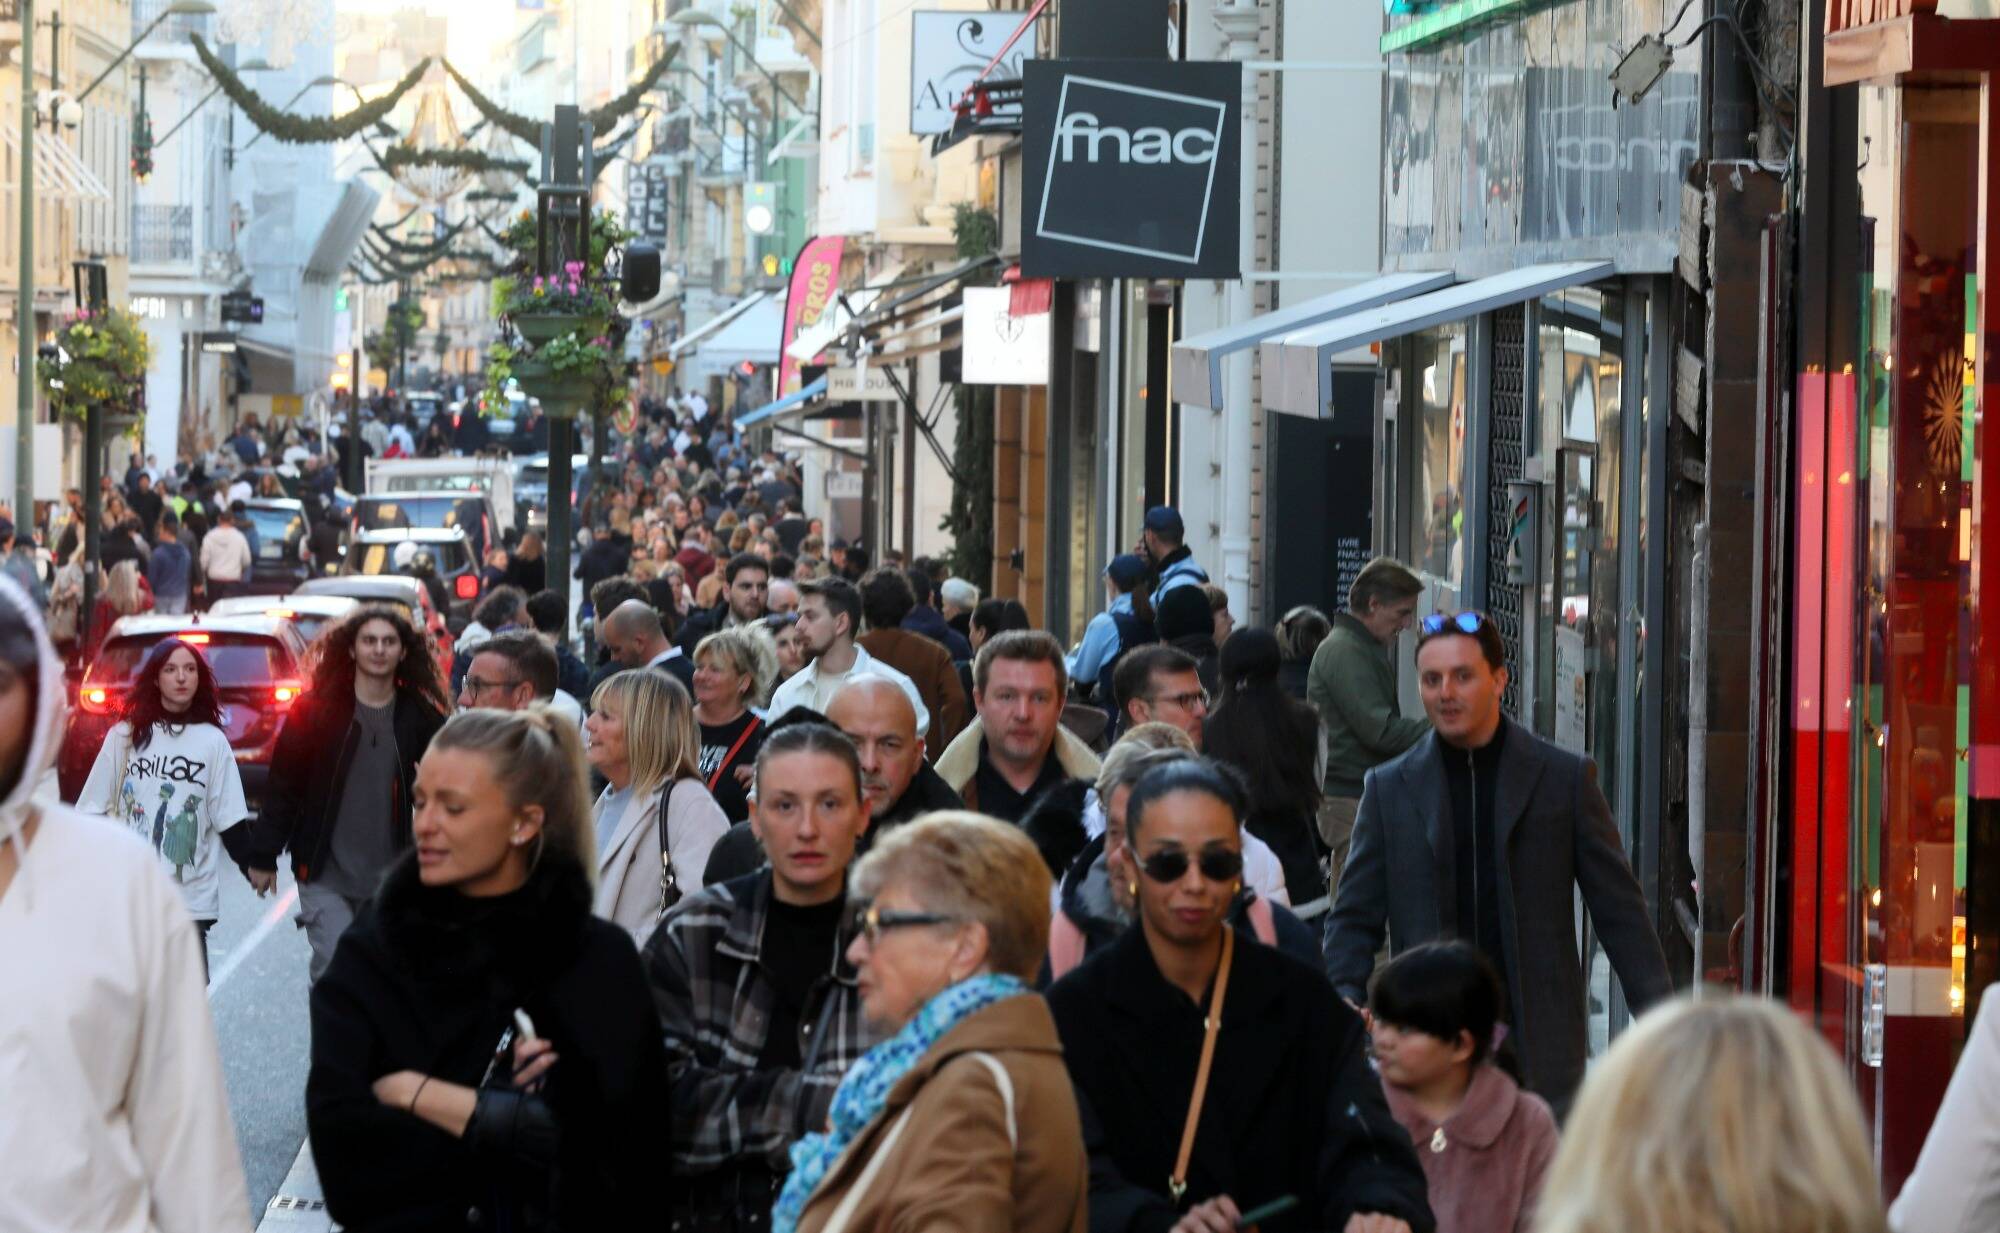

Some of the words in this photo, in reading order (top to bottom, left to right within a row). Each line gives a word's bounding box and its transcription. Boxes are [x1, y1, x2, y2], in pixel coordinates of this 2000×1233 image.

[1058, 111, 1216, 164] fnac
[1337, 537, 1360, 548] LIVRE
[1337, 549, 1360, 560] FNAC
